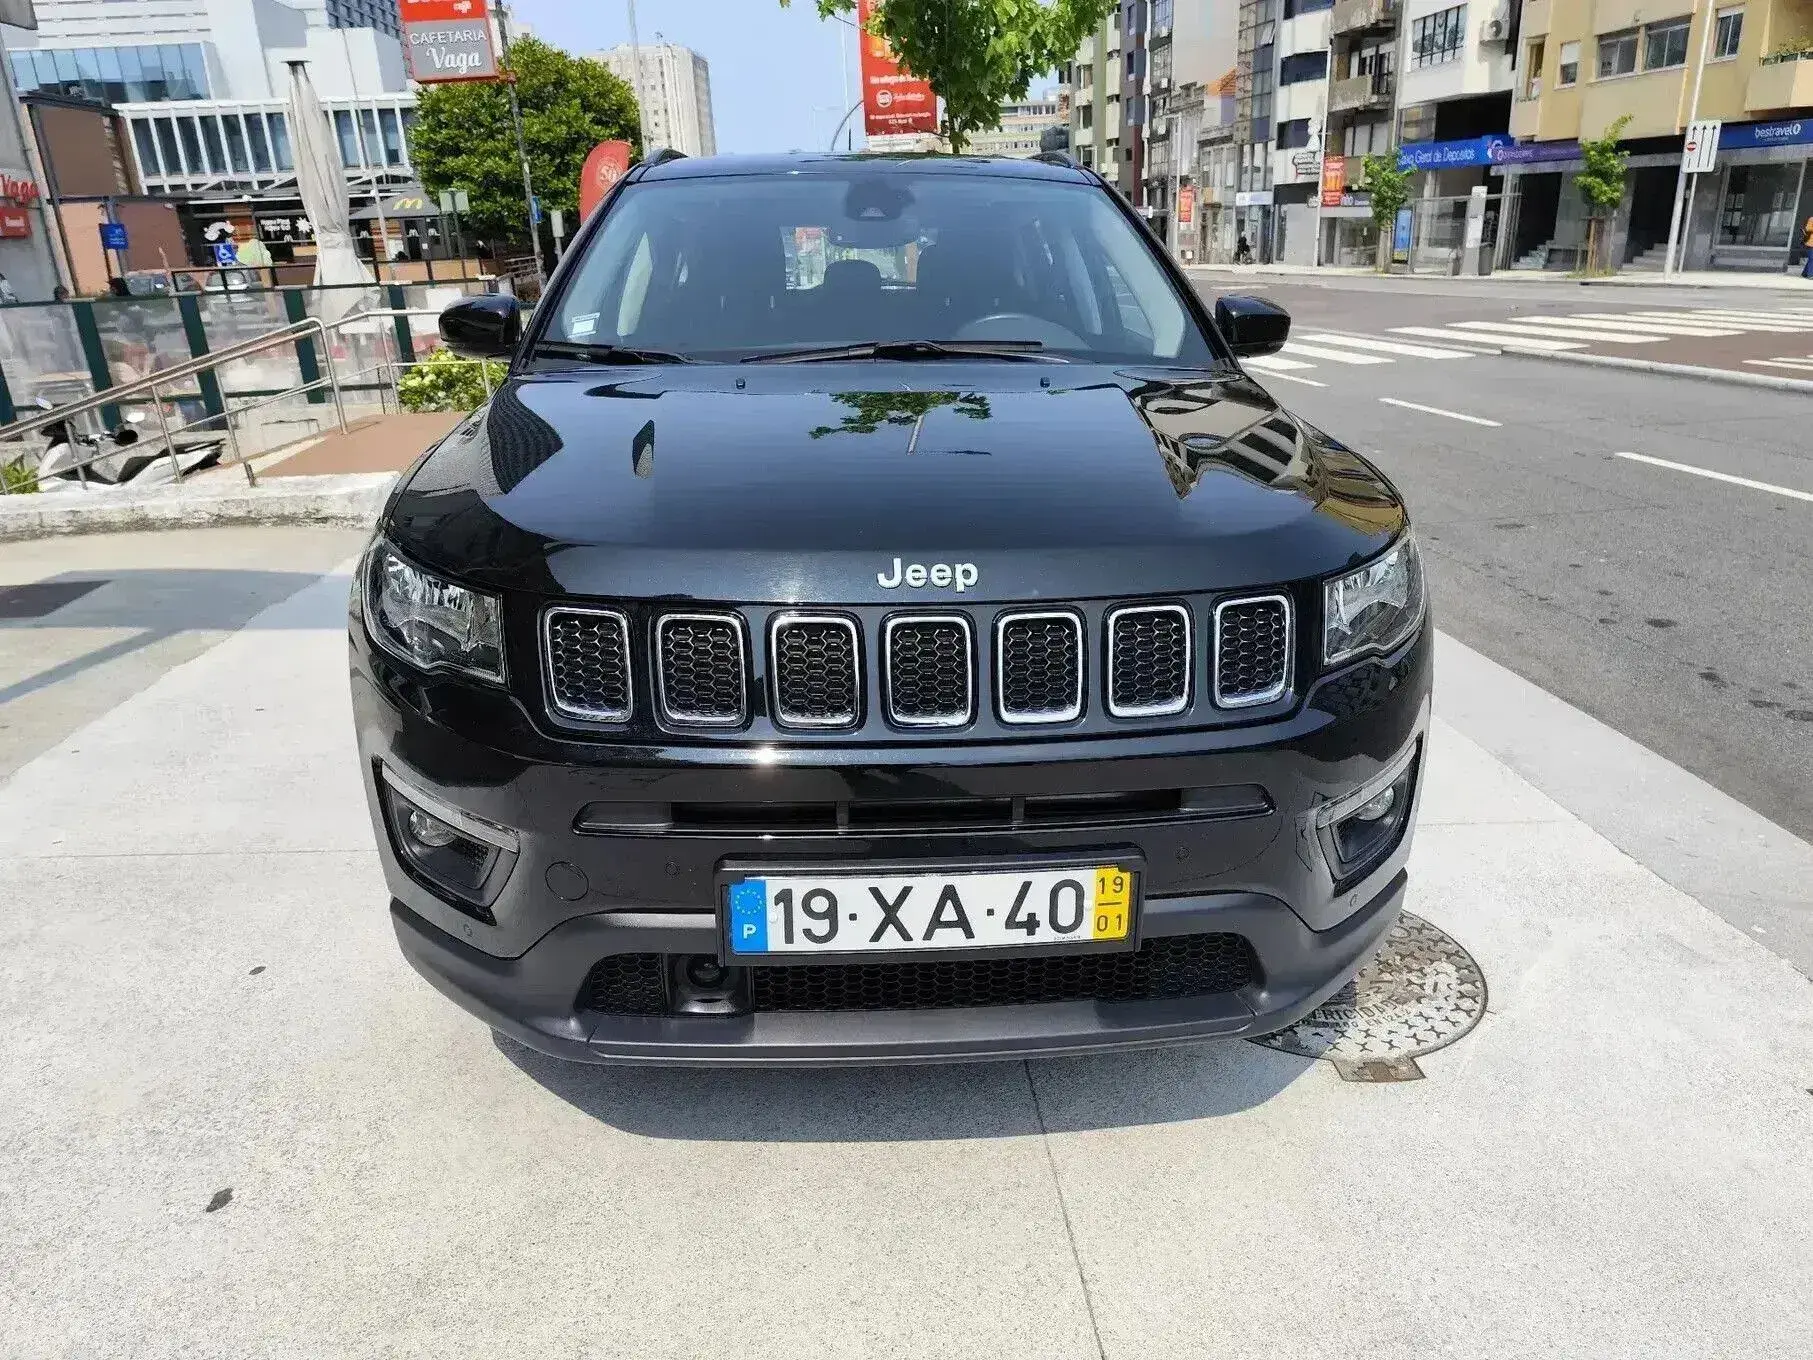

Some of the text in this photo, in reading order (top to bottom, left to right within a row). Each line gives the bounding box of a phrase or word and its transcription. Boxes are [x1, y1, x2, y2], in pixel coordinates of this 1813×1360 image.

[409, 29, 487, 45] CAFETARIA
[426, 47, 482, 75] Vaga
[877, 557, 979, 594] Jeep
[1098, 875, 1124, 895] 19
[742, 923, 757, 939] P
[1096, 913, 1123, 932] 01
